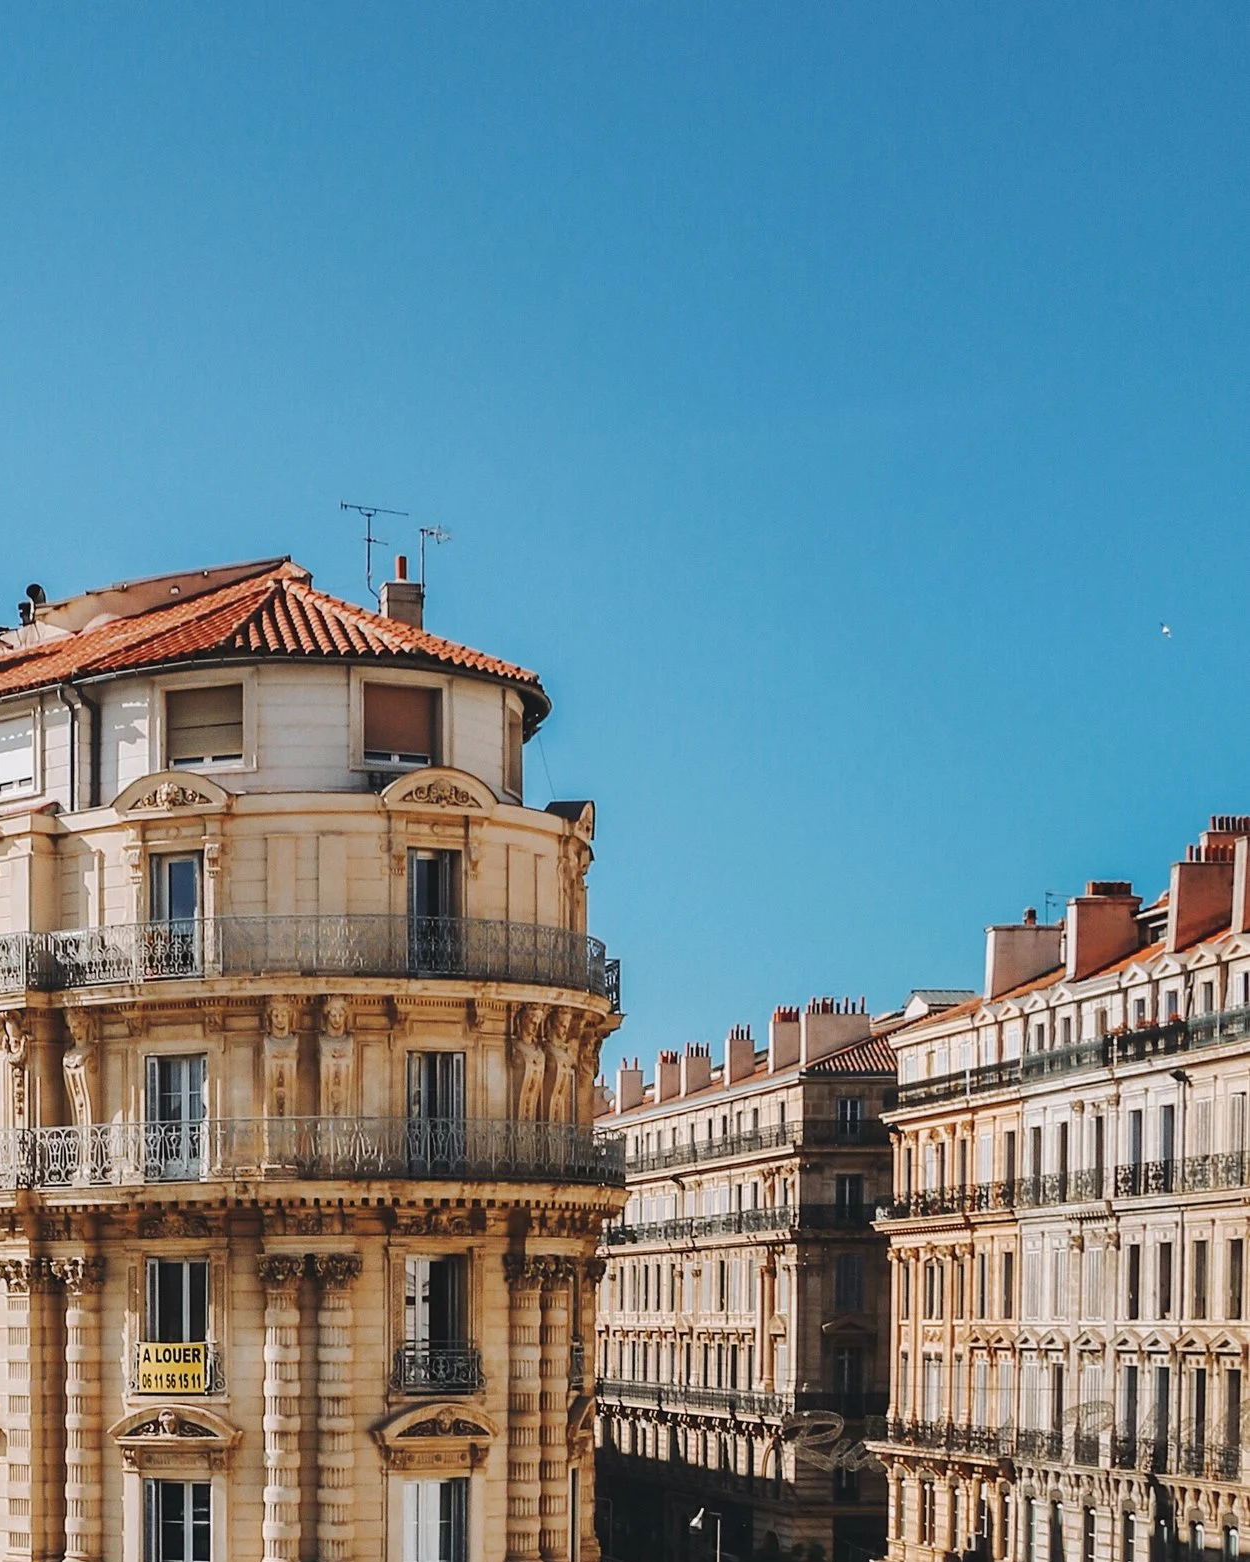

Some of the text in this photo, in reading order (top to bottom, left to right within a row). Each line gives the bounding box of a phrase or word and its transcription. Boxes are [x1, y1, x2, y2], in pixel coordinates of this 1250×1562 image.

[143, 1348, 201, 1363] A LOUER
[143, 1373, 201, 1389] 06 11 56 15 11
